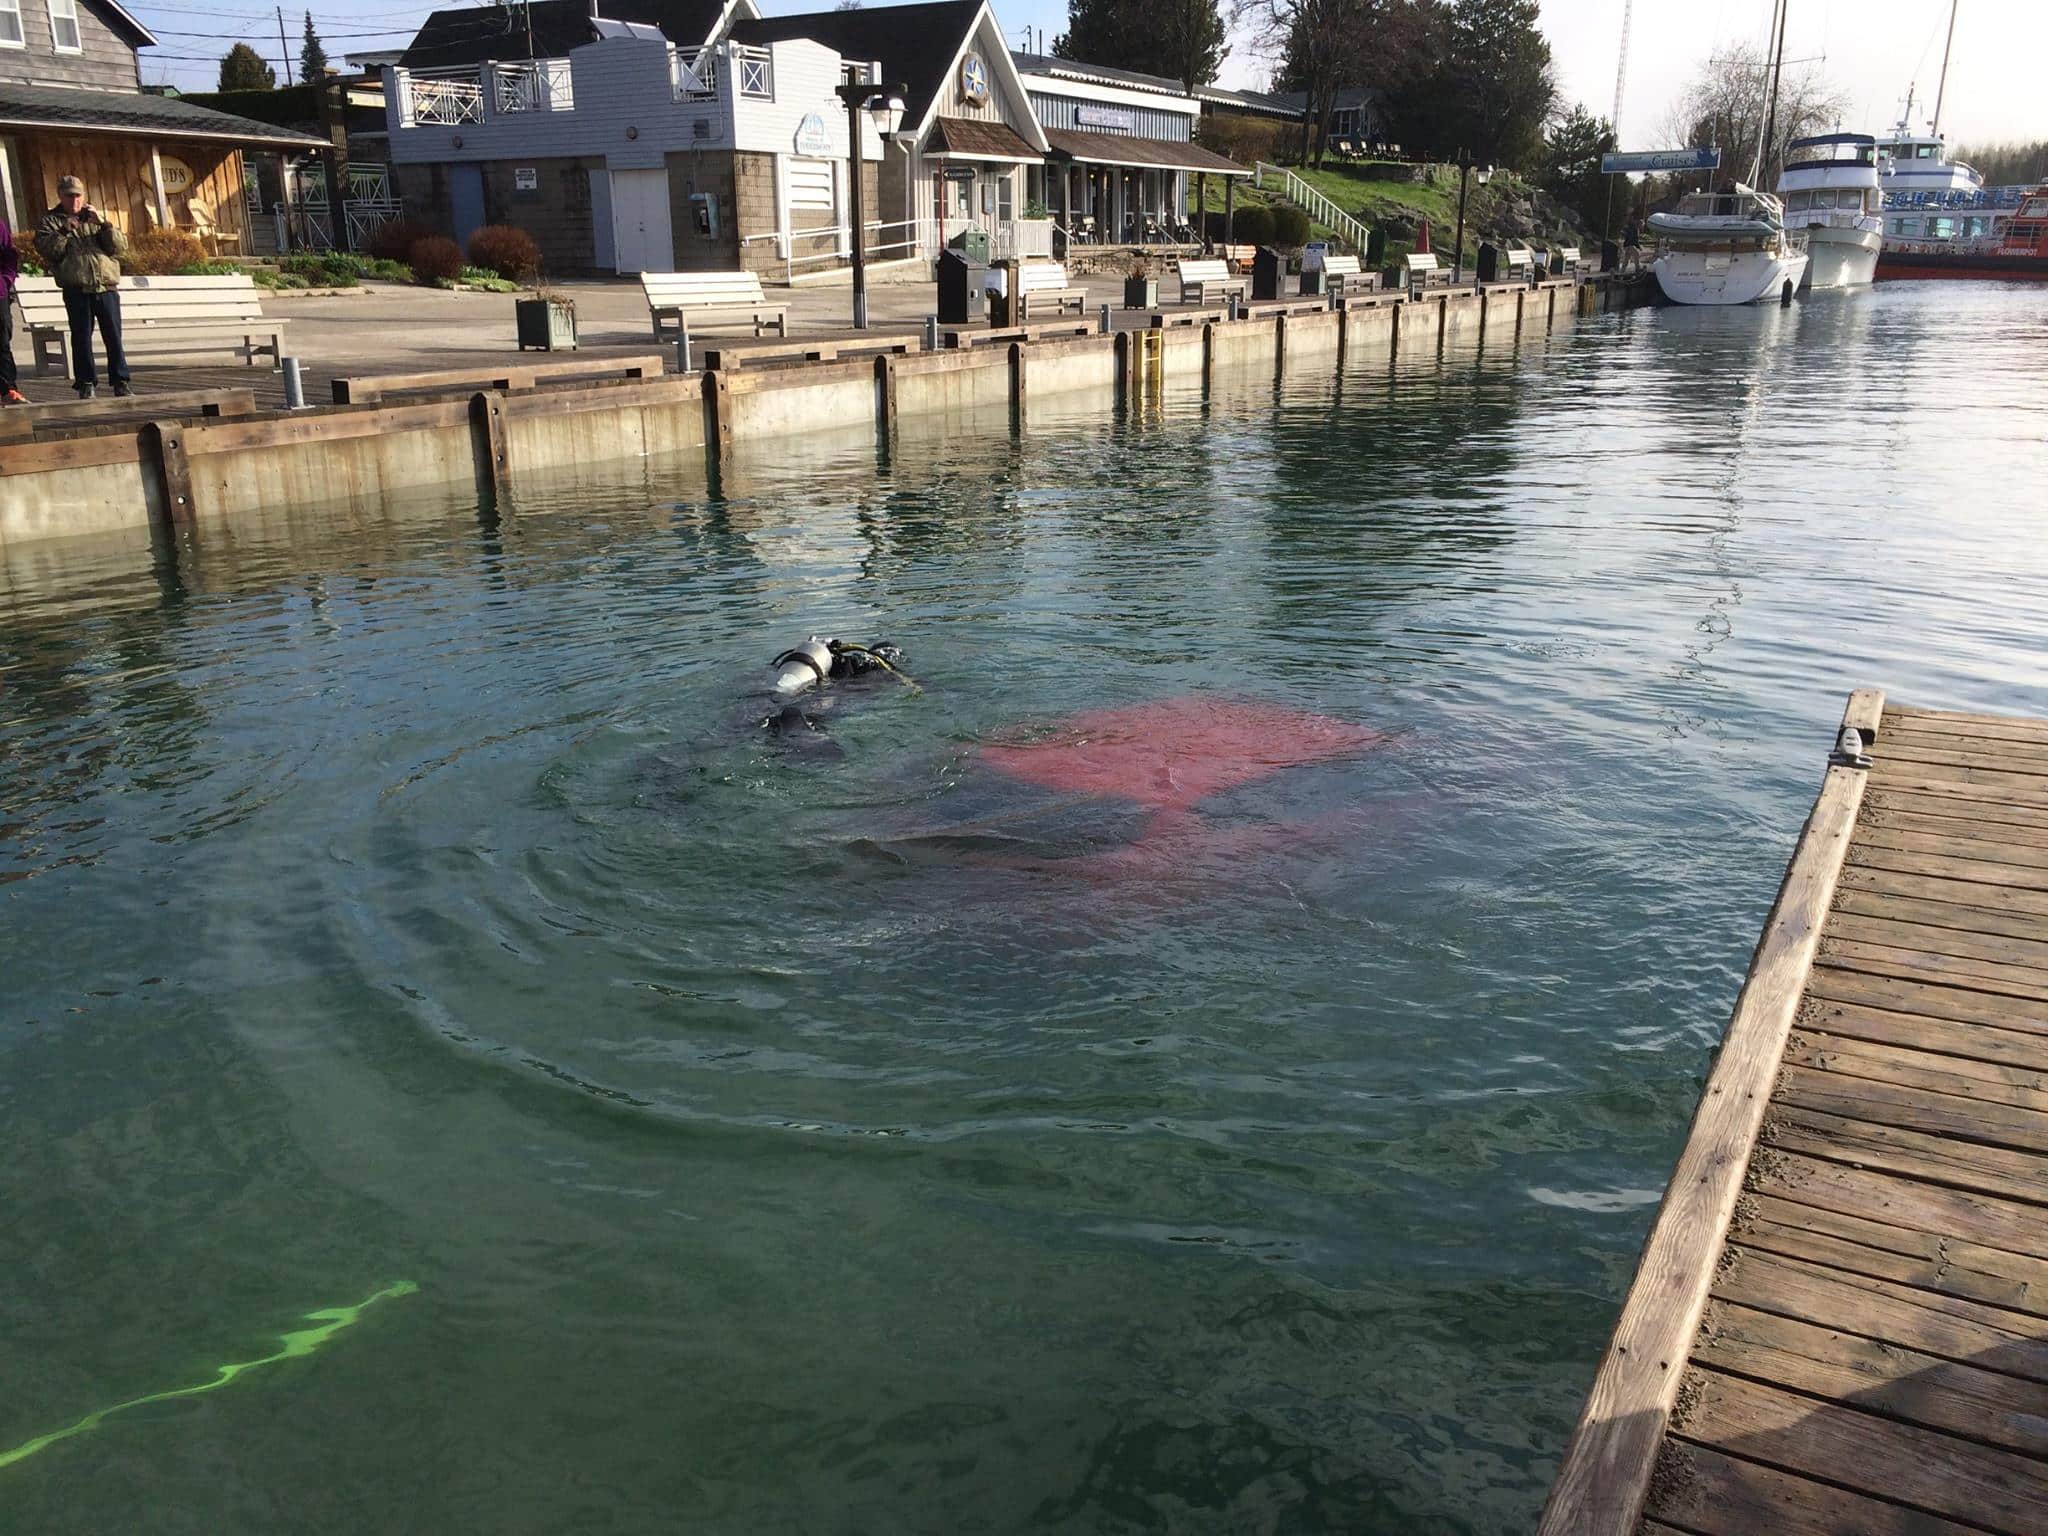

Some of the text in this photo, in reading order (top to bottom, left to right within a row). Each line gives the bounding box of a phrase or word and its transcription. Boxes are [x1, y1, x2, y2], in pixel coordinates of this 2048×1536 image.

[1650, 154, 1695, 168] Cruises
[161, 167, 186, 183] UD'S
[1997, 248, 2038, 256] FLOWERPOT
